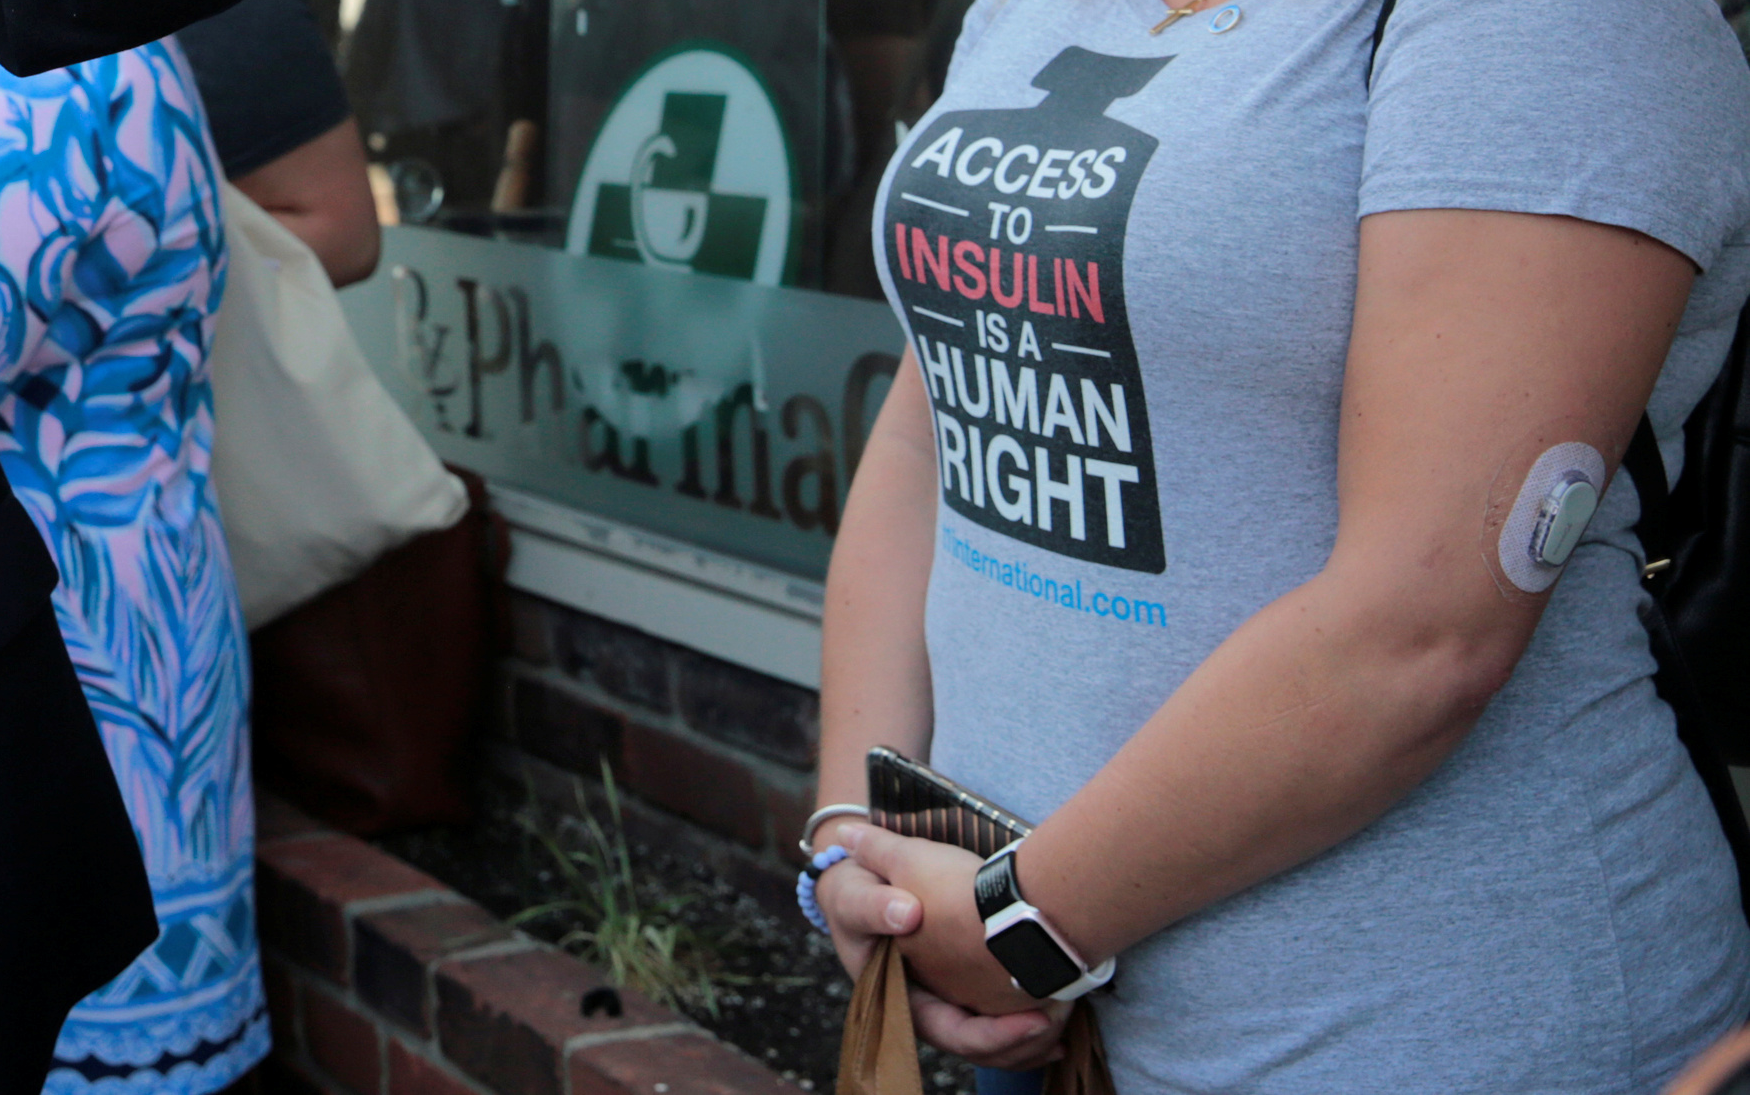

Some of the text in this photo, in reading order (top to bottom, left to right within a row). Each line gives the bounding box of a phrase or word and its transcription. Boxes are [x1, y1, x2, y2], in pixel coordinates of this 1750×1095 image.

[910, 126, 1127, 200] ACCESS
[988, 202, 1033, 245] TO
[895, 222, 1105, 324] INSULIN
[976, 309, 1043, 361] IS A
[918, 334, 1132, 453] HUMAN
[936, 408, 1139, 549] RIGHT
